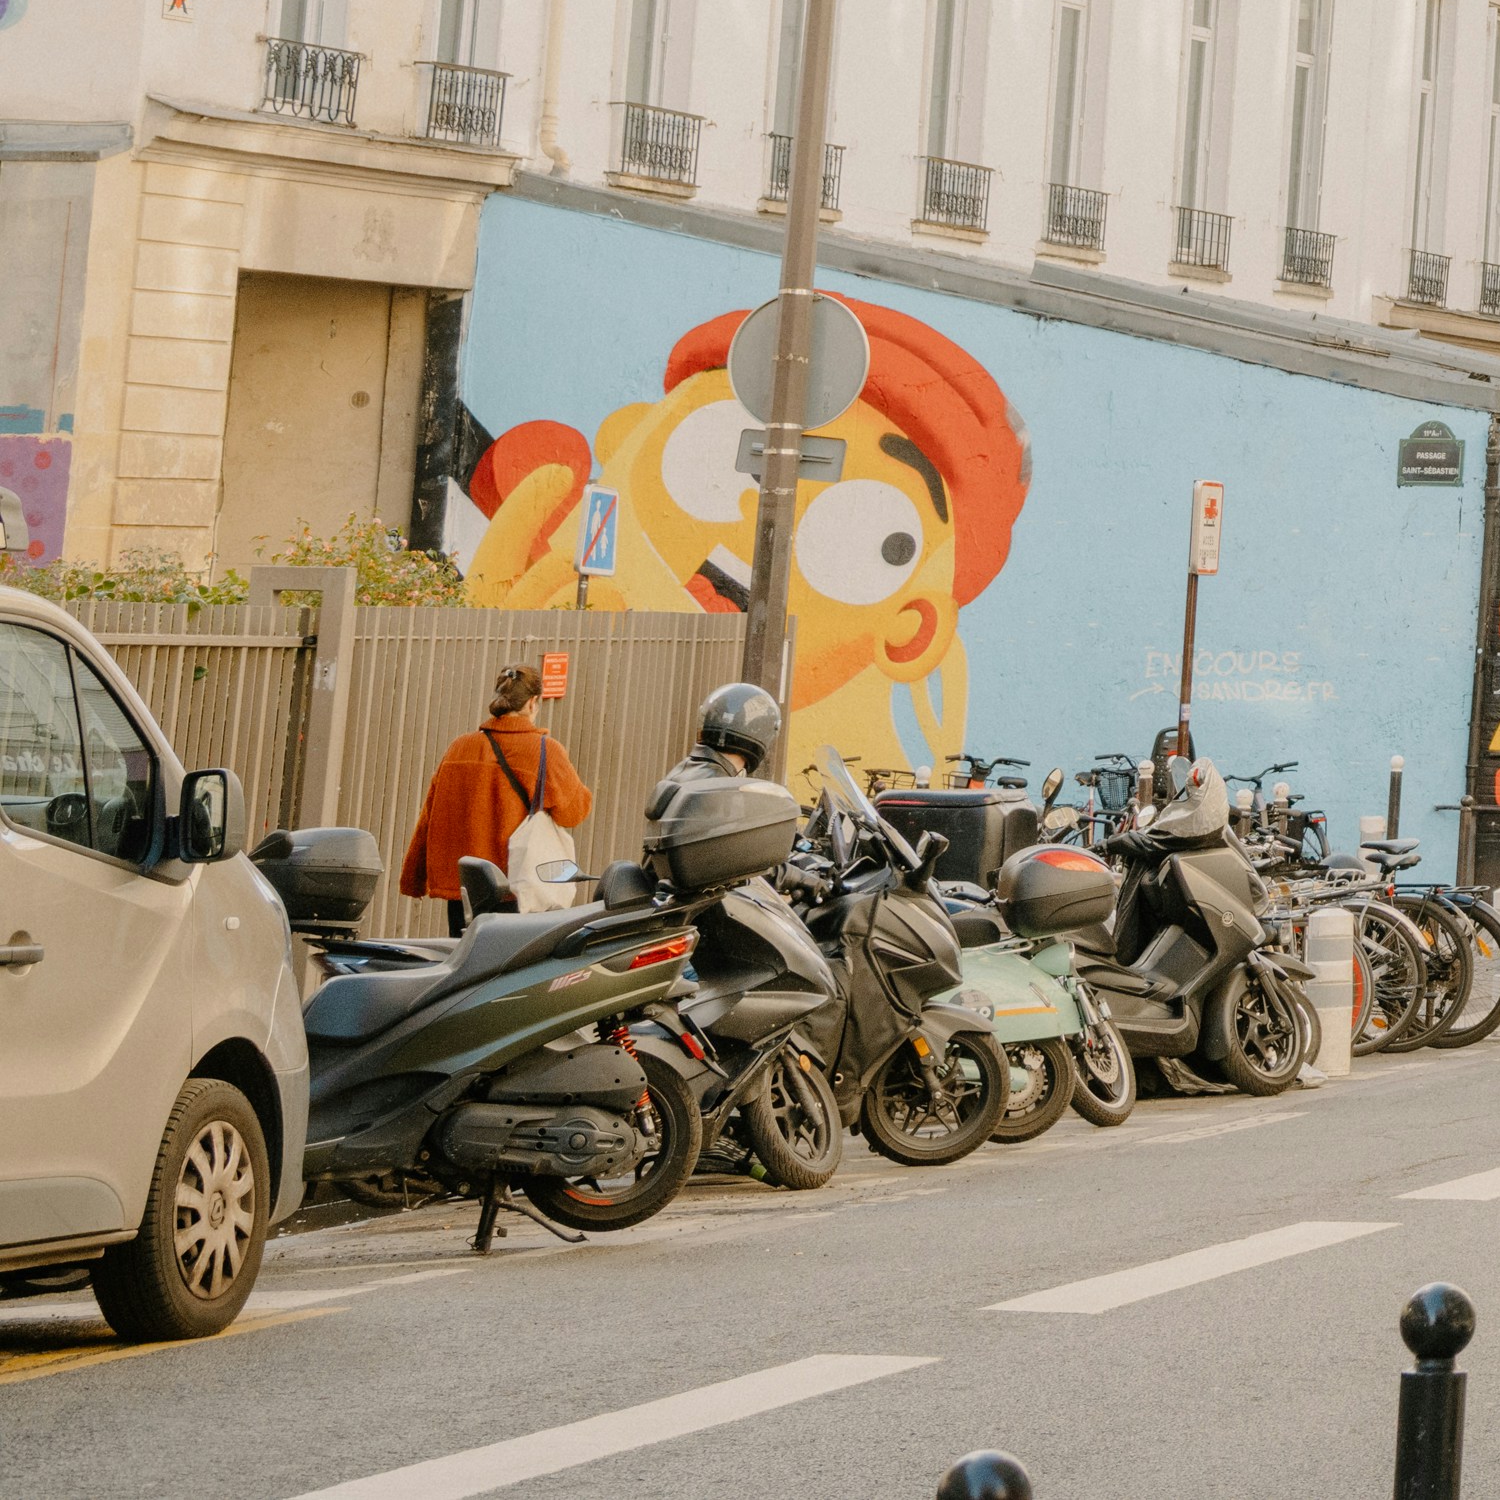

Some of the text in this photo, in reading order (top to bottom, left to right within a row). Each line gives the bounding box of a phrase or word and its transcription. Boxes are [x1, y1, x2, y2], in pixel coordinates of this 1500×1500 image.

[1402, 466, 1459, 475] SAINT-SÉBASTIEN
[1145, 649, 1302, 678] EN COURS
